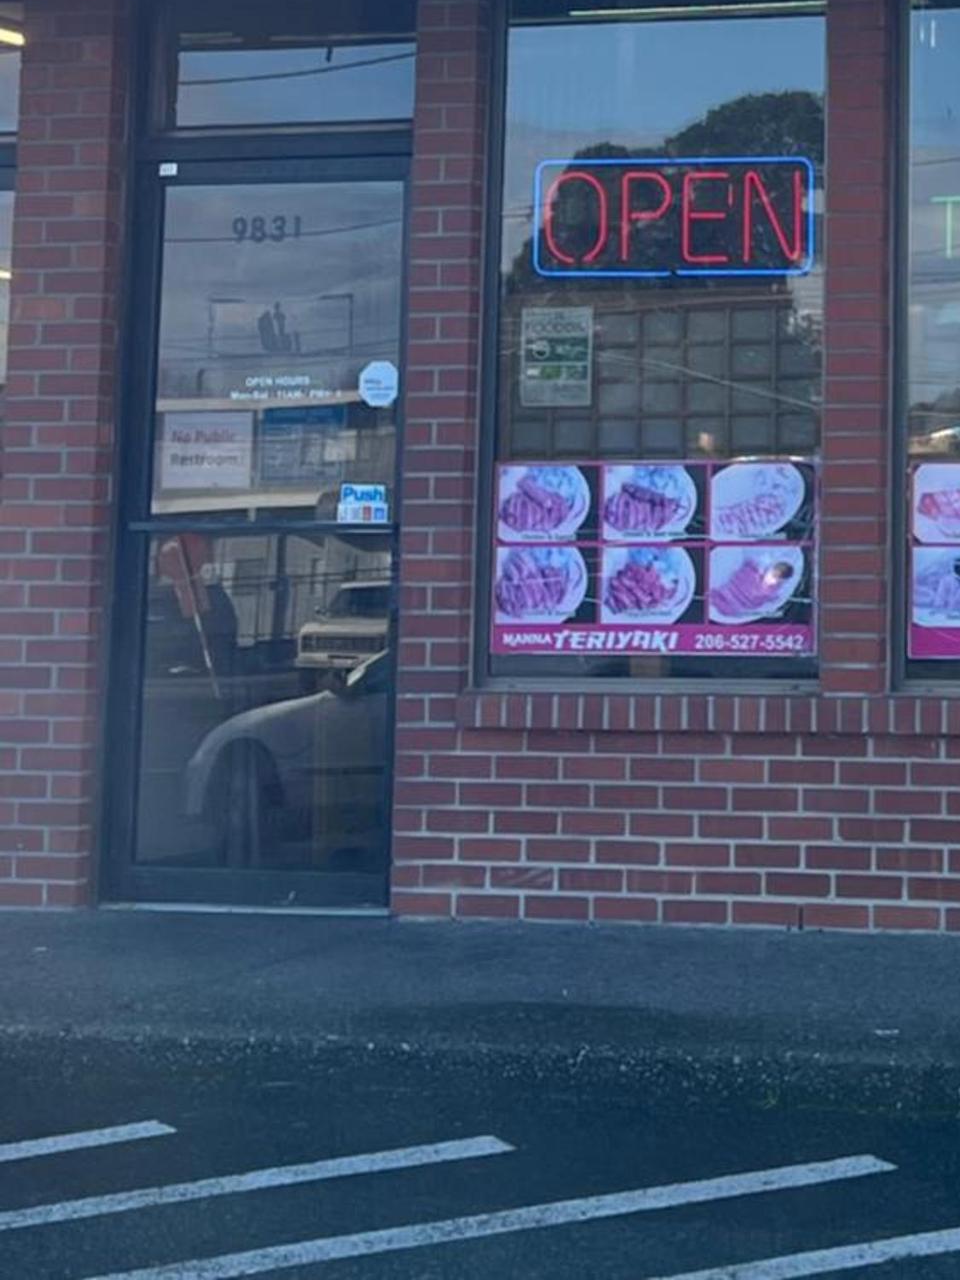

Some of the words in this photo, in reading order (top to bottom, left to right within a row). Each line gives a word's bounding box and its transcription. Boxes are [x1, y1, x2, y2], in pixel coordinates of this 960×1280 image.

[543, 171, 803, 264] OPEN
[232, 216, 302, 243] 9831
[245, 376, 273, 387] OPEN
[275, 375, 310, 386] HOURS
[171, 429, 192, 444] No
[195, 428, 235, 443] Public
[343, 487, 384, 502] Push
[502, 632, 552, 647] MANNA
[553, 629, 679, 652] TERIYAKI
[695, 633, 804, 651] 206-527-5542
